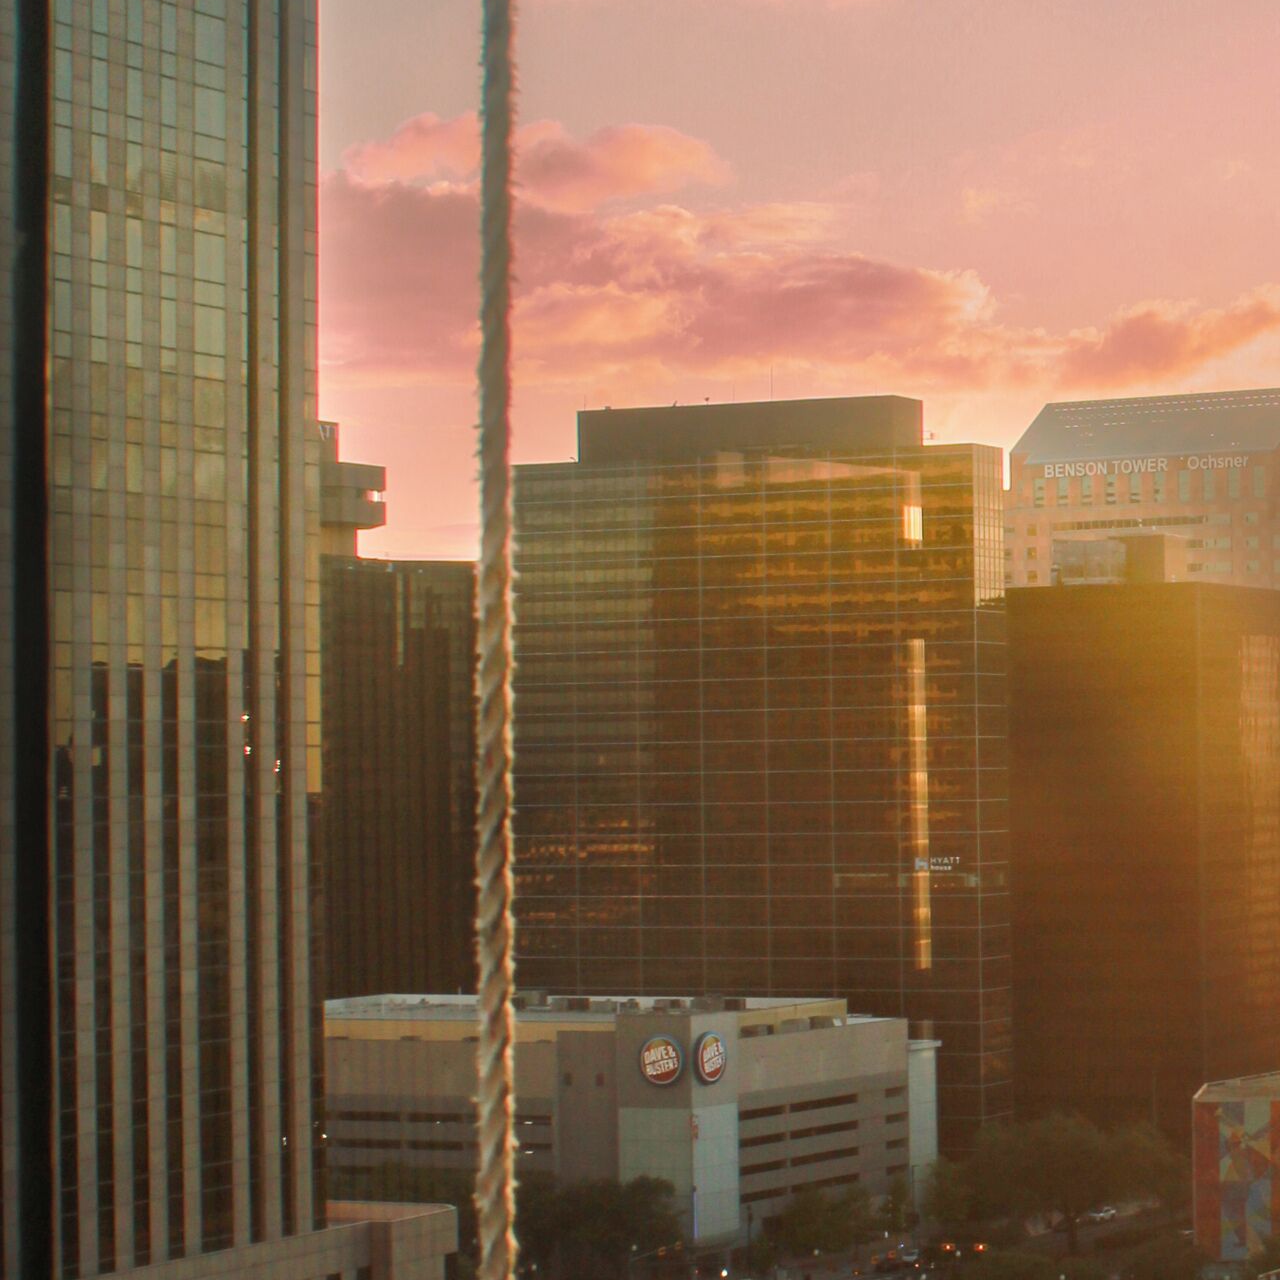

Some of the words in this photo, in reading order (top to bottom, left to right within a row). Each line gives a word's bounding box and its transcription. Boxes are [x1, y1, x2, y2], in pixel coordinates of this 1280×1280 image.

[1044, 461, 1107, 478] BENSON
[1112, 458, 1168, 474] TOWER
[1187, 455, 1248, 470] Ochsner
[930, 856, 960, 864] HYATT
[644, 1046, 667, 1064] DAVE
